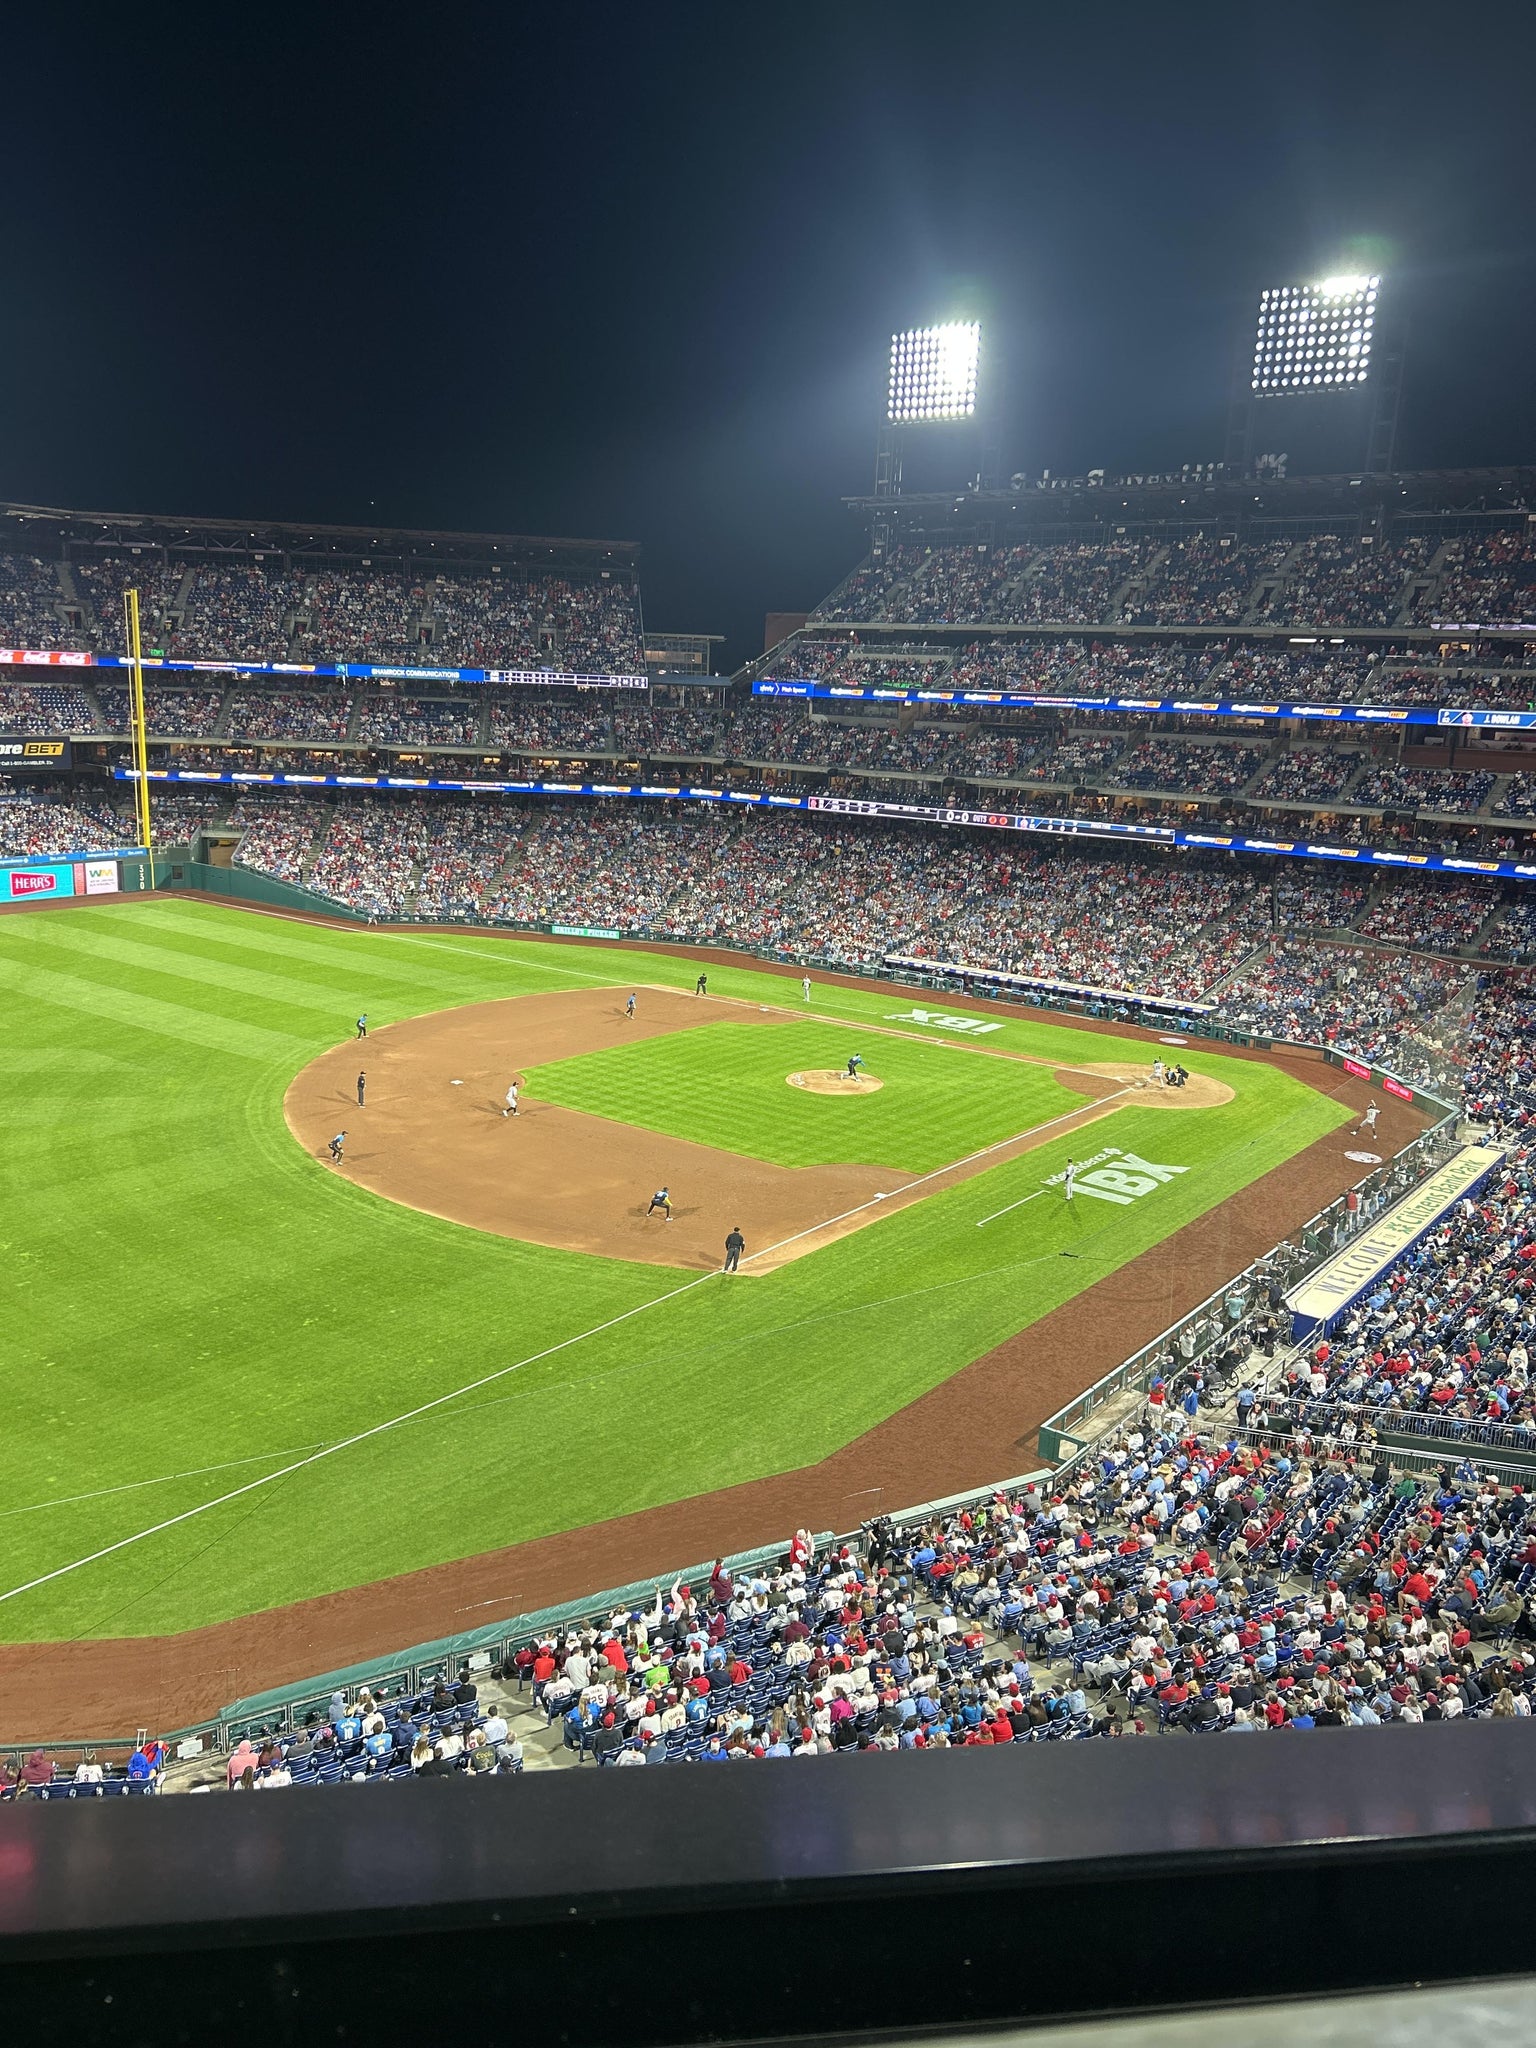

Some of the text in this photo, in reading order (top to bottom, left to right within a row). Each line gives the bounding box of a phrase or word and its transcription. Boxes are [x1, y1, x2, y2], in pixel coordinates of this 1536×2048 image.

[371, 668, 460, 678] SHAMROCK COMMUNICATIONS
[28, 744, 61, 754] BET
[946, 811, 969, 823] 0-0
[973, 814, 987, 823] OUTS
[89, 869, 113, 877] WM
[15, 876, 51, 889] HERR'S
[1070, 1153, 1192, 1205] IBX
[1395, 1159, 1486, 1225] Citizens Bank Park
[1314, 1238, 1398, 1295] WELCOME
